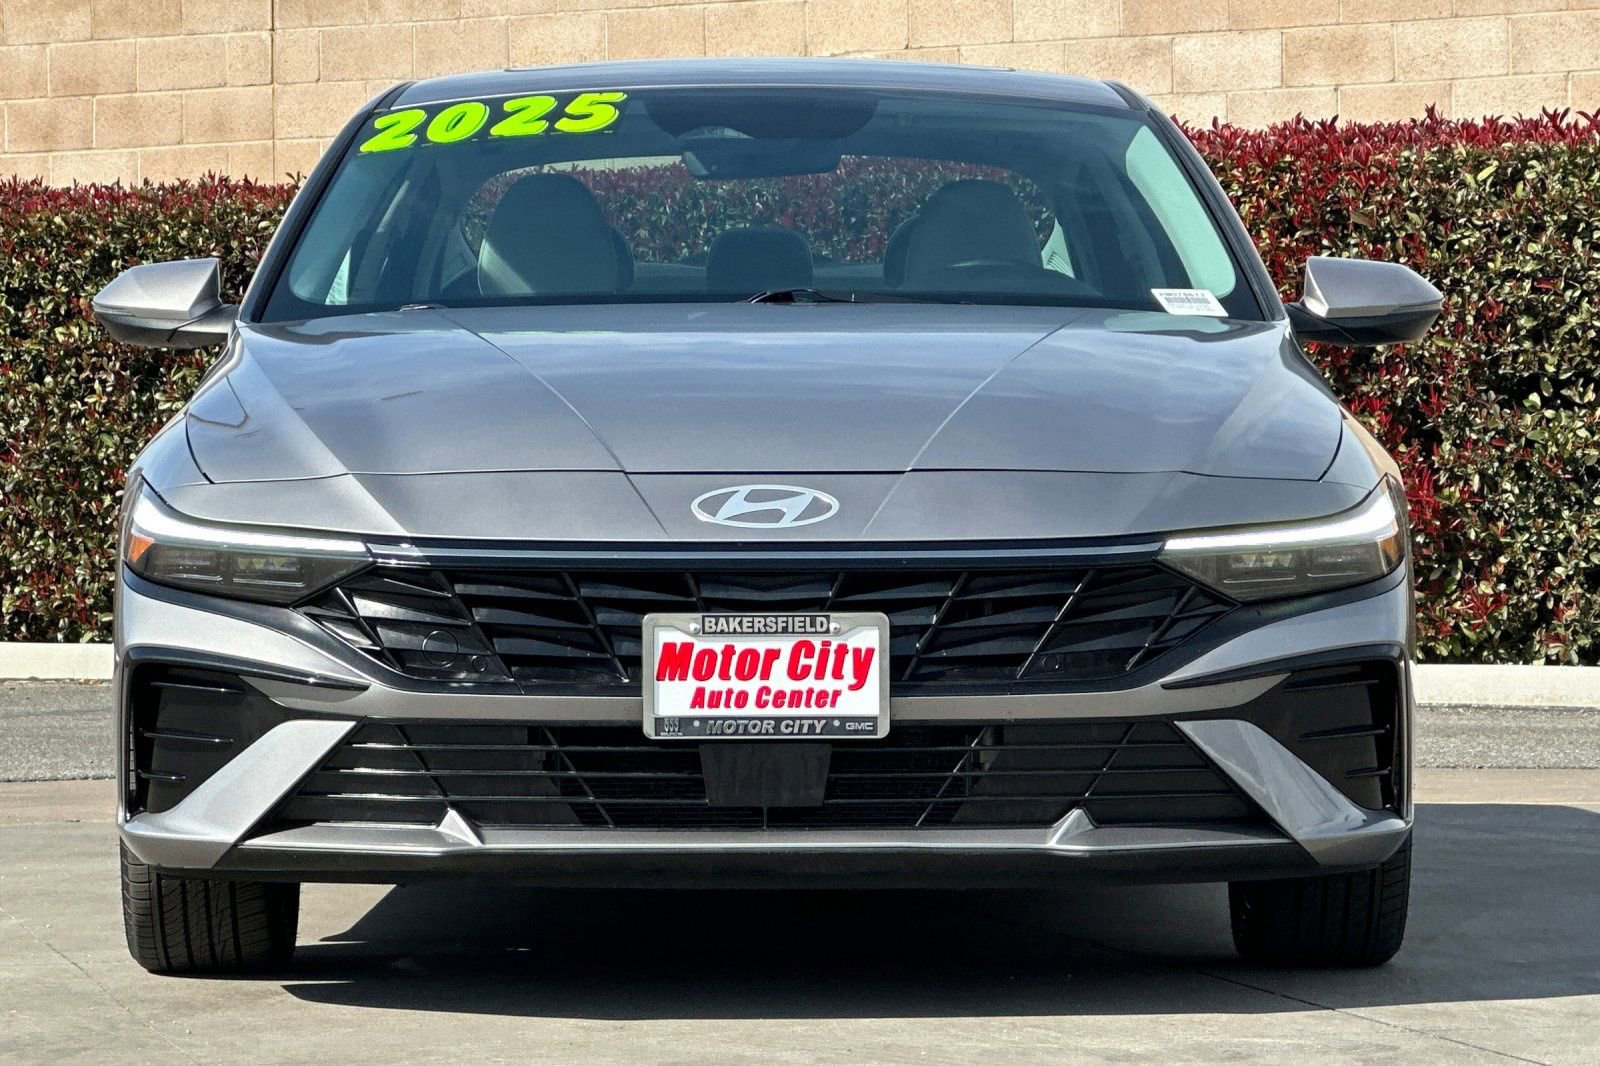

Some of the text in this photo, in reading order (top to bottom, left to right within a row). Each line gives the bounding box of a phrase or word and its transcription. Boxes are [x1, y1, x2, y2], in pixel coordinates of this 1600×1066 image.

[359, 92, 628, 153] 2025
[704, 616, 829, 633] BAKERSFIELD
[656, 640, 875, 690] Motor City
[689, 685, 842, 709] Auto Center
[706, 719, 827, 734] MOTOR CITY
[845, 722, 873, 730] GMC
